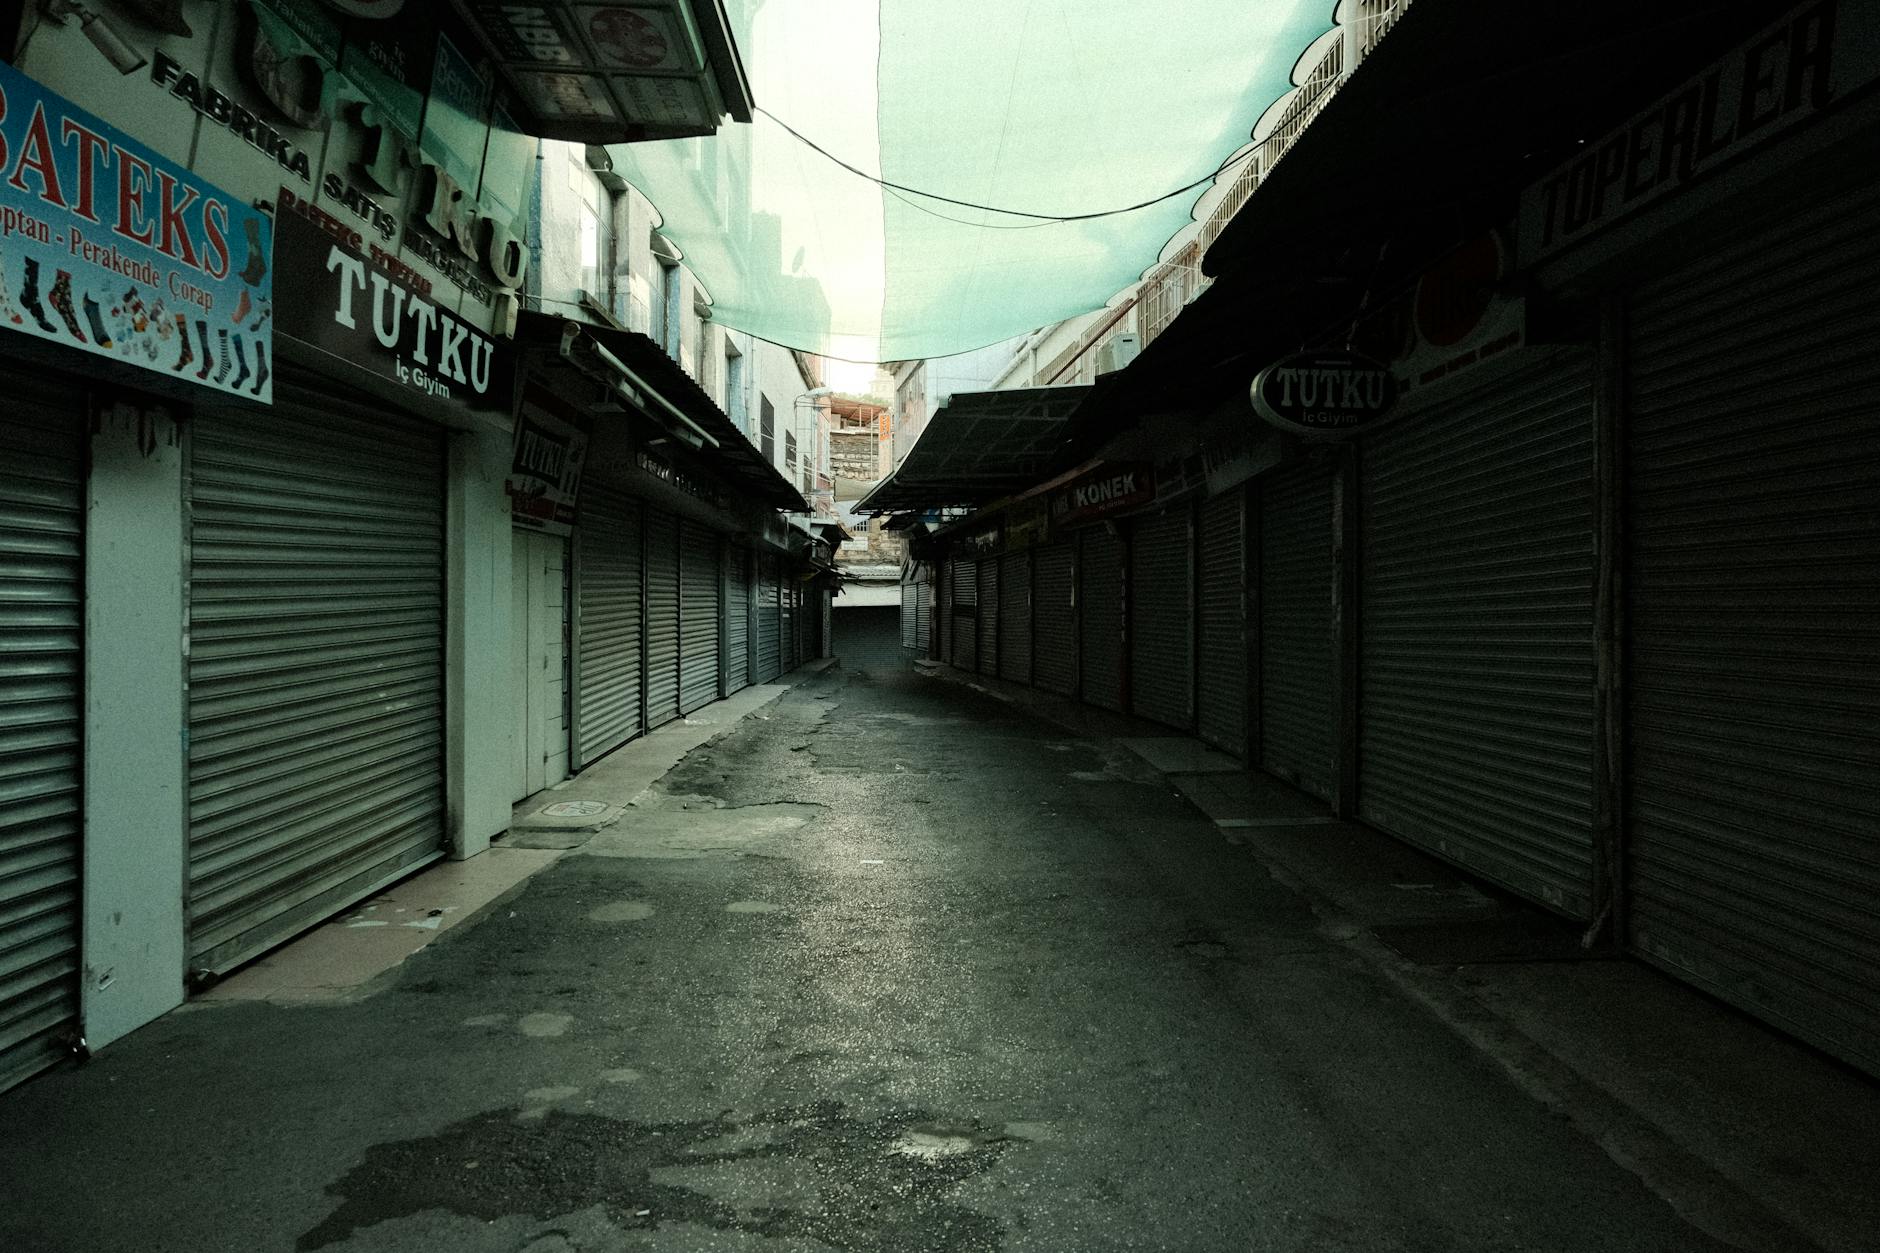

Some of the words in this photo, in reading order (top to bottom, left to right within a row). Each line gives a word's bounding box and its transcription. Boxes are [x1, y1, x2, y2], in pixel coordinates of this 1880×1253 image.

[323, 172, 397, 241] SATIŞ
[70, 227, 161, 290] Perakende
[168, 271, 214, 316] Çorap
[326, 246, 495, 395] TUTKU
[412, 368, 451, 399] Giyim
[1277, 367, 1386, 410] TUTKU
[1318, 411, 1358, 426] Giyim
